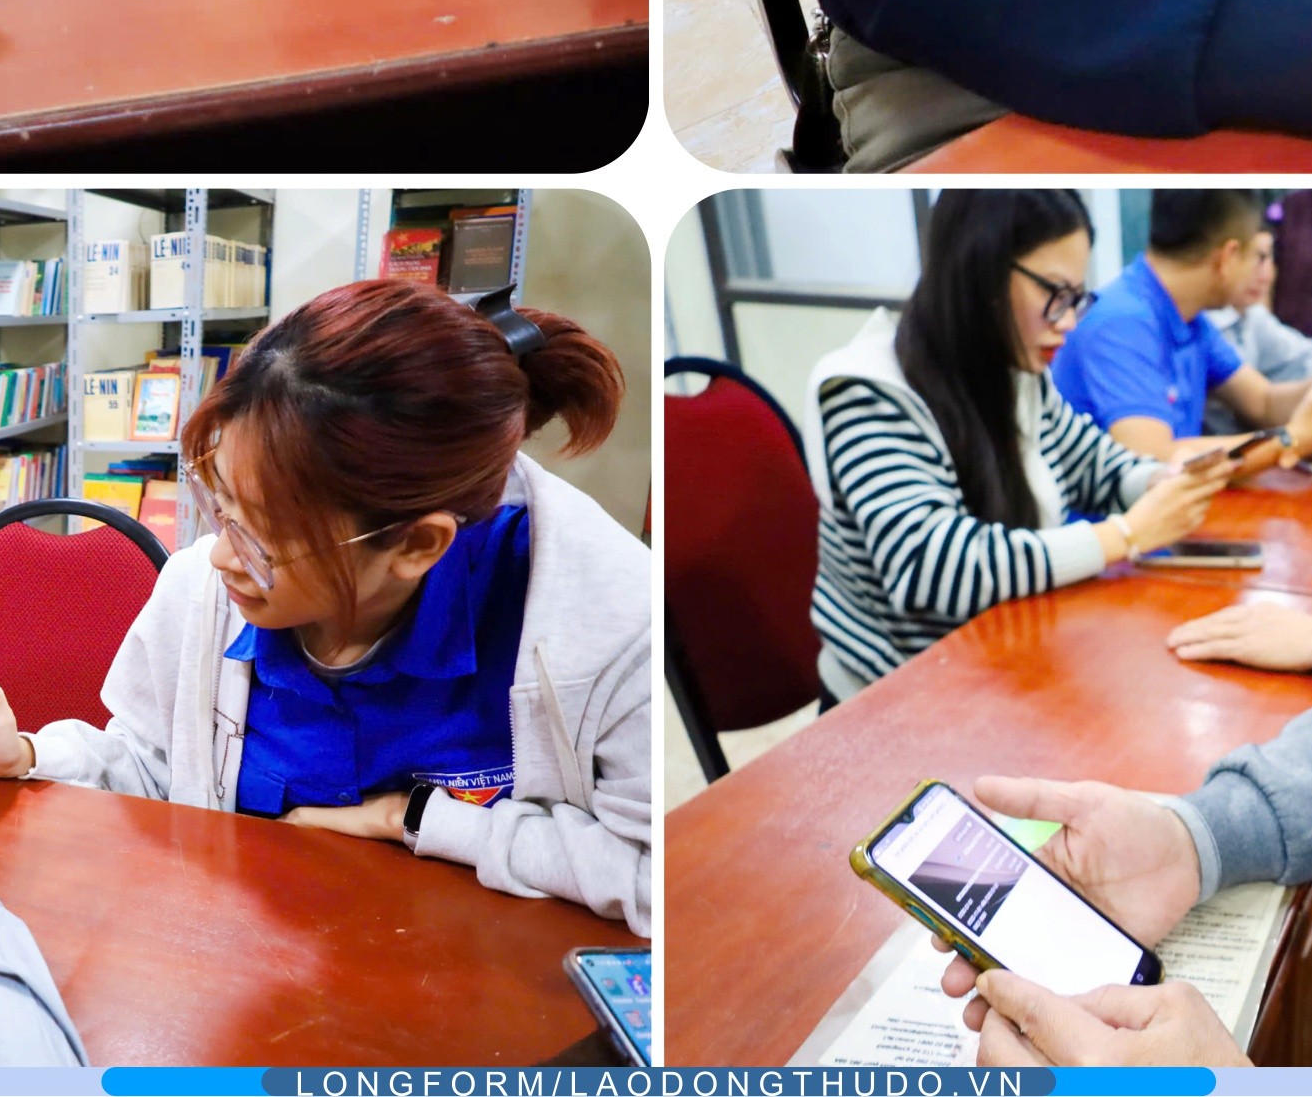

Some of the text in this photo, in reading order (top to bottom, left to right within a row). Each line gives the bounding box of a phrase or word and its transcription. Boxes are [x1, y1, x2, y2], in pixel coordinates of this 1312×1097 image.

[448, 776, 469, 787] NIÊN
[470, 773, 491, 788] VIỆT
[493, 771, 514, 783] NAM
